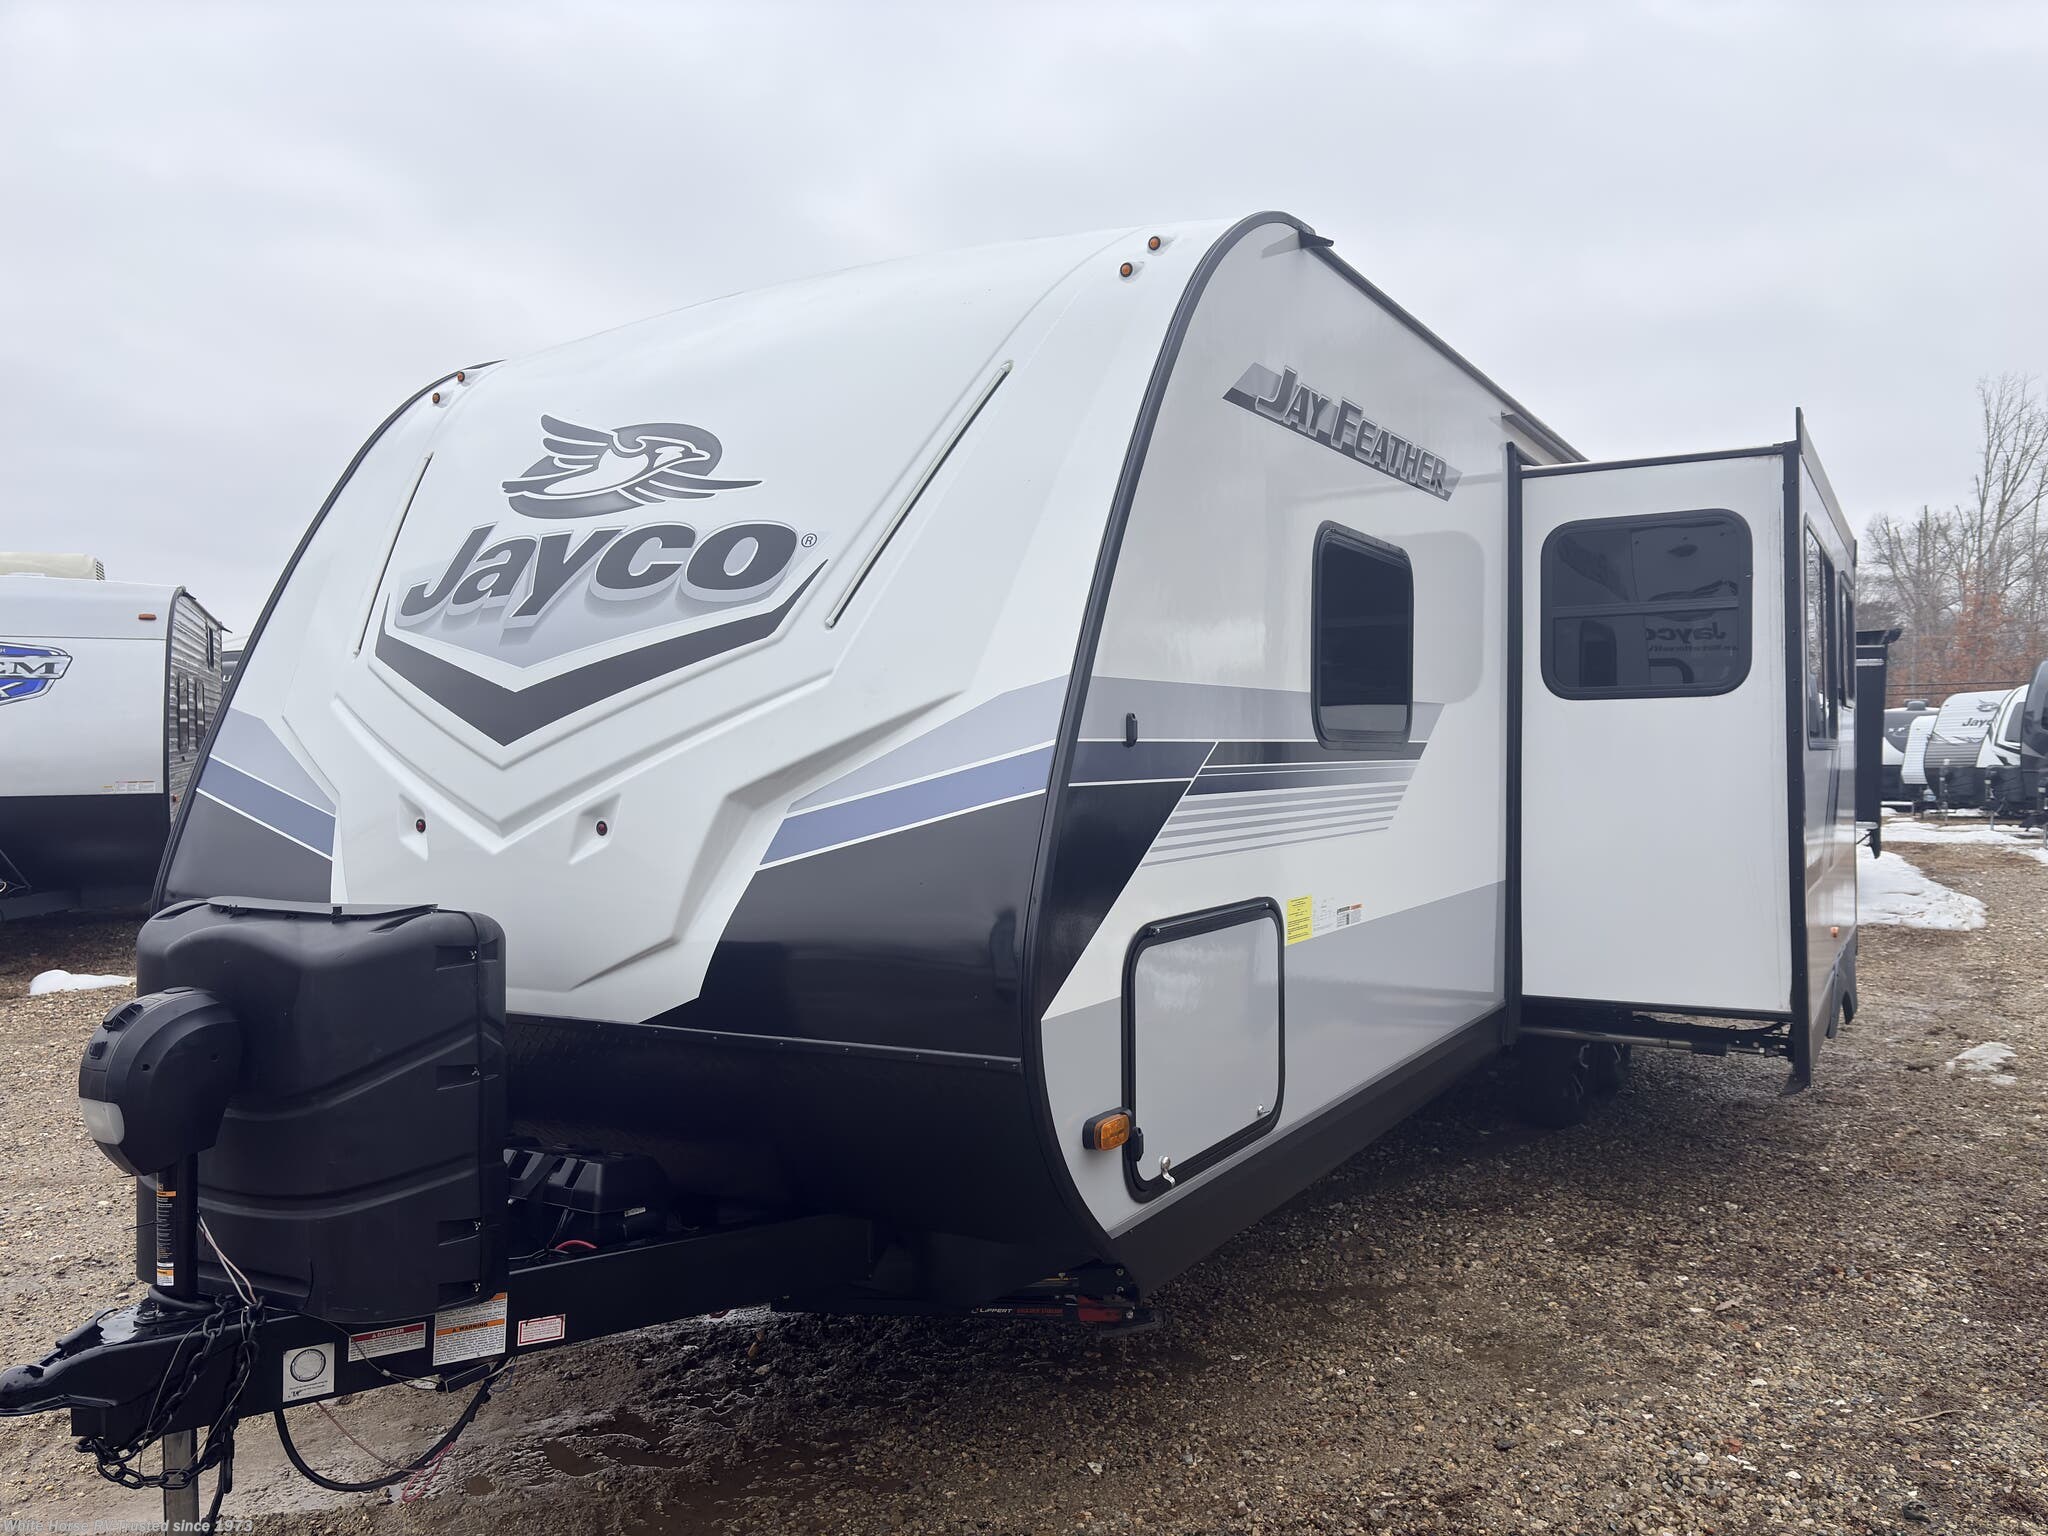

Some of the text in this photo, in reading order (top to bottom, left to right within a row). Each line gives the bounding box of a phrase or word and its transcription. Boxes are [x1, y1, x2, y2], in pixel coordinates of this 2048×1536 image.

[1256, 365, 1447, 496] JAY FEATHER
[398, 520, 799, 624] Jayco
[376, 1328, 405, 1338] DANGER
[459, 1321, 489, 1332] WARNING
